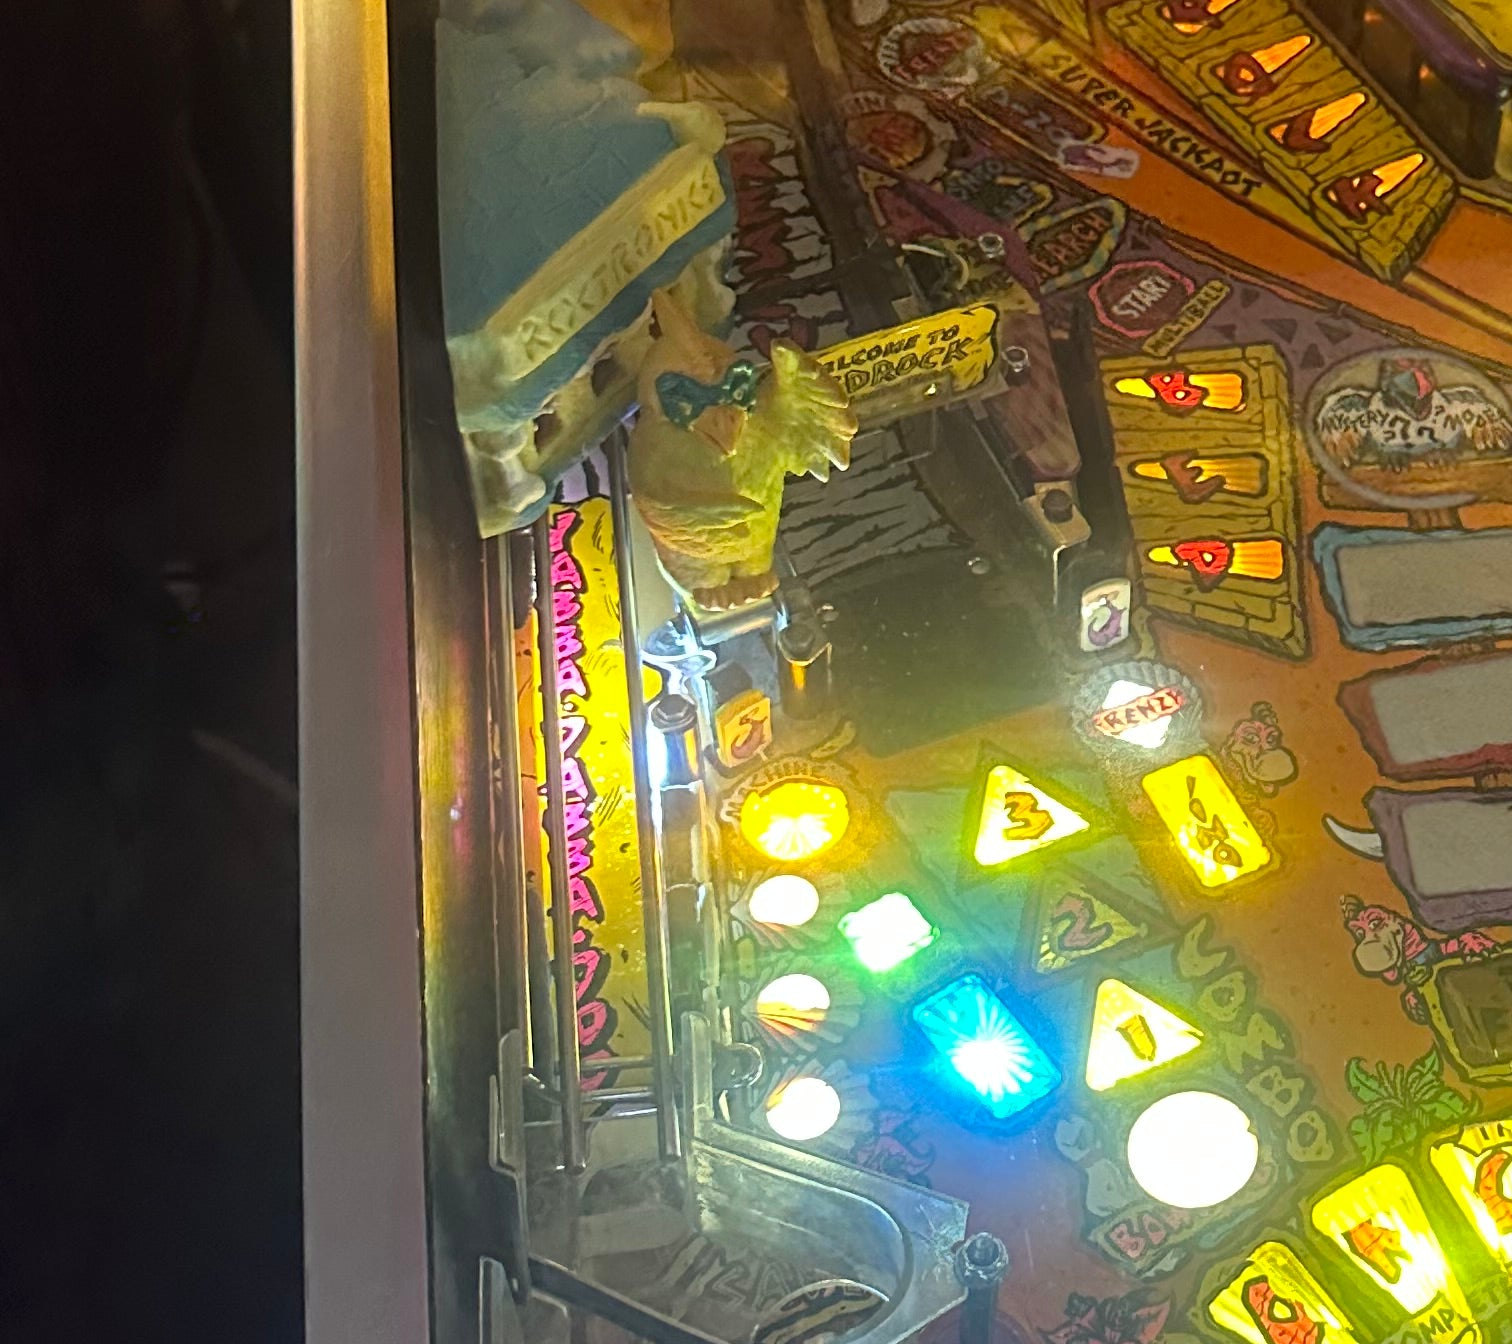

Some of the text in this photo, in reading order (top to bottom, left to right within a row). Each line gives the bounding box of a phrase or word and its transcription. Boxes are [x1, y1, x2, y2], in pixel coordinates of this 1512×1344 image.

[1048, 56, 1263, 197] SUPER JACKPOT
[1111, 273, 1172, 320] START
[927, 324, 960, 346] TO
[1004, 789, 1055, 841] 3
[1053, 893, 1113, 950] 2
[1177, 917, 1335, 1163] COMBO
